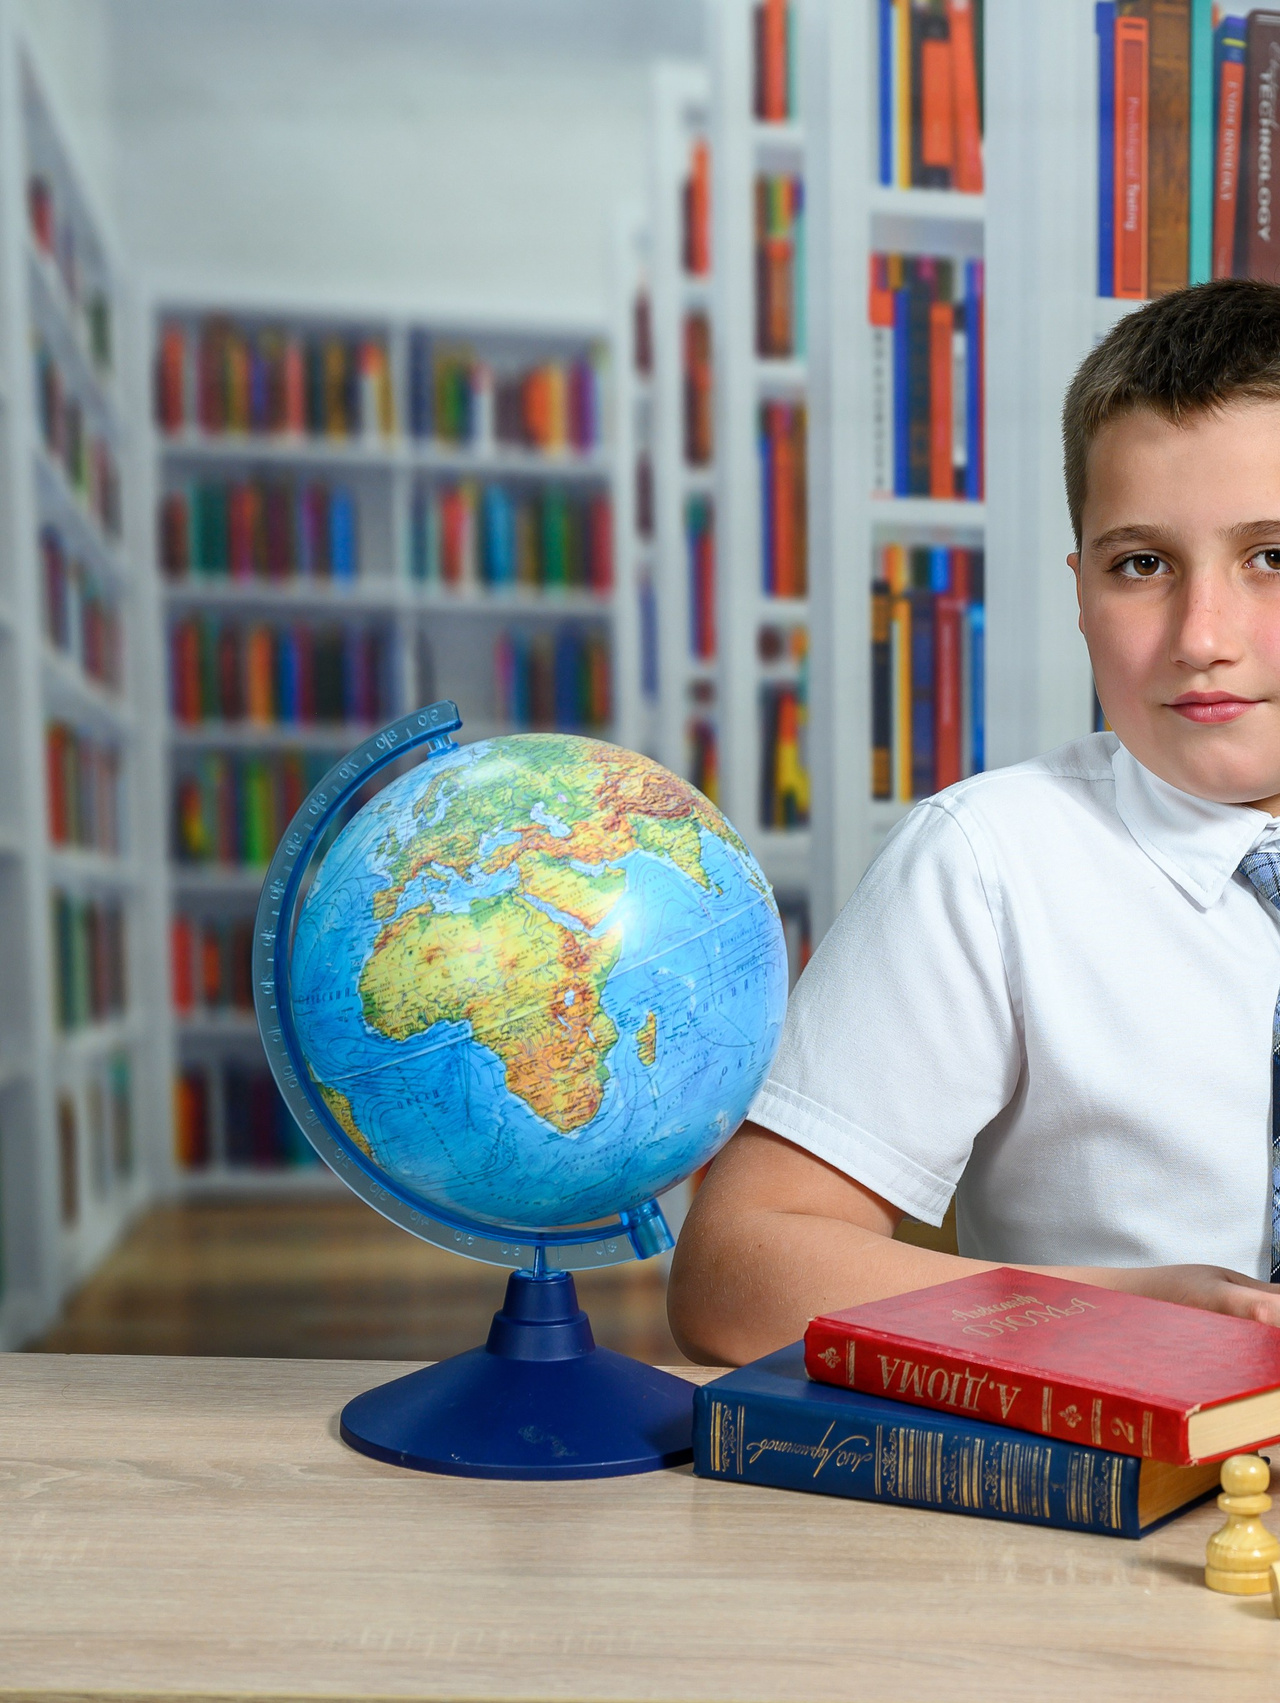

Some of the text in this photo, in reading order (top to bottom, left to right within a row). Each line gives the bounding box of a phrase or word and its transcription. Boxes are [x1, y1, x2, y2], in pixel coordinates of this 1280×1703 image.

[1257, 73, 1273, 242] TECHNOLOGY
[1124, 183, 1141, 231] Testing
[1110, 1417, 1134, 1444] 2
